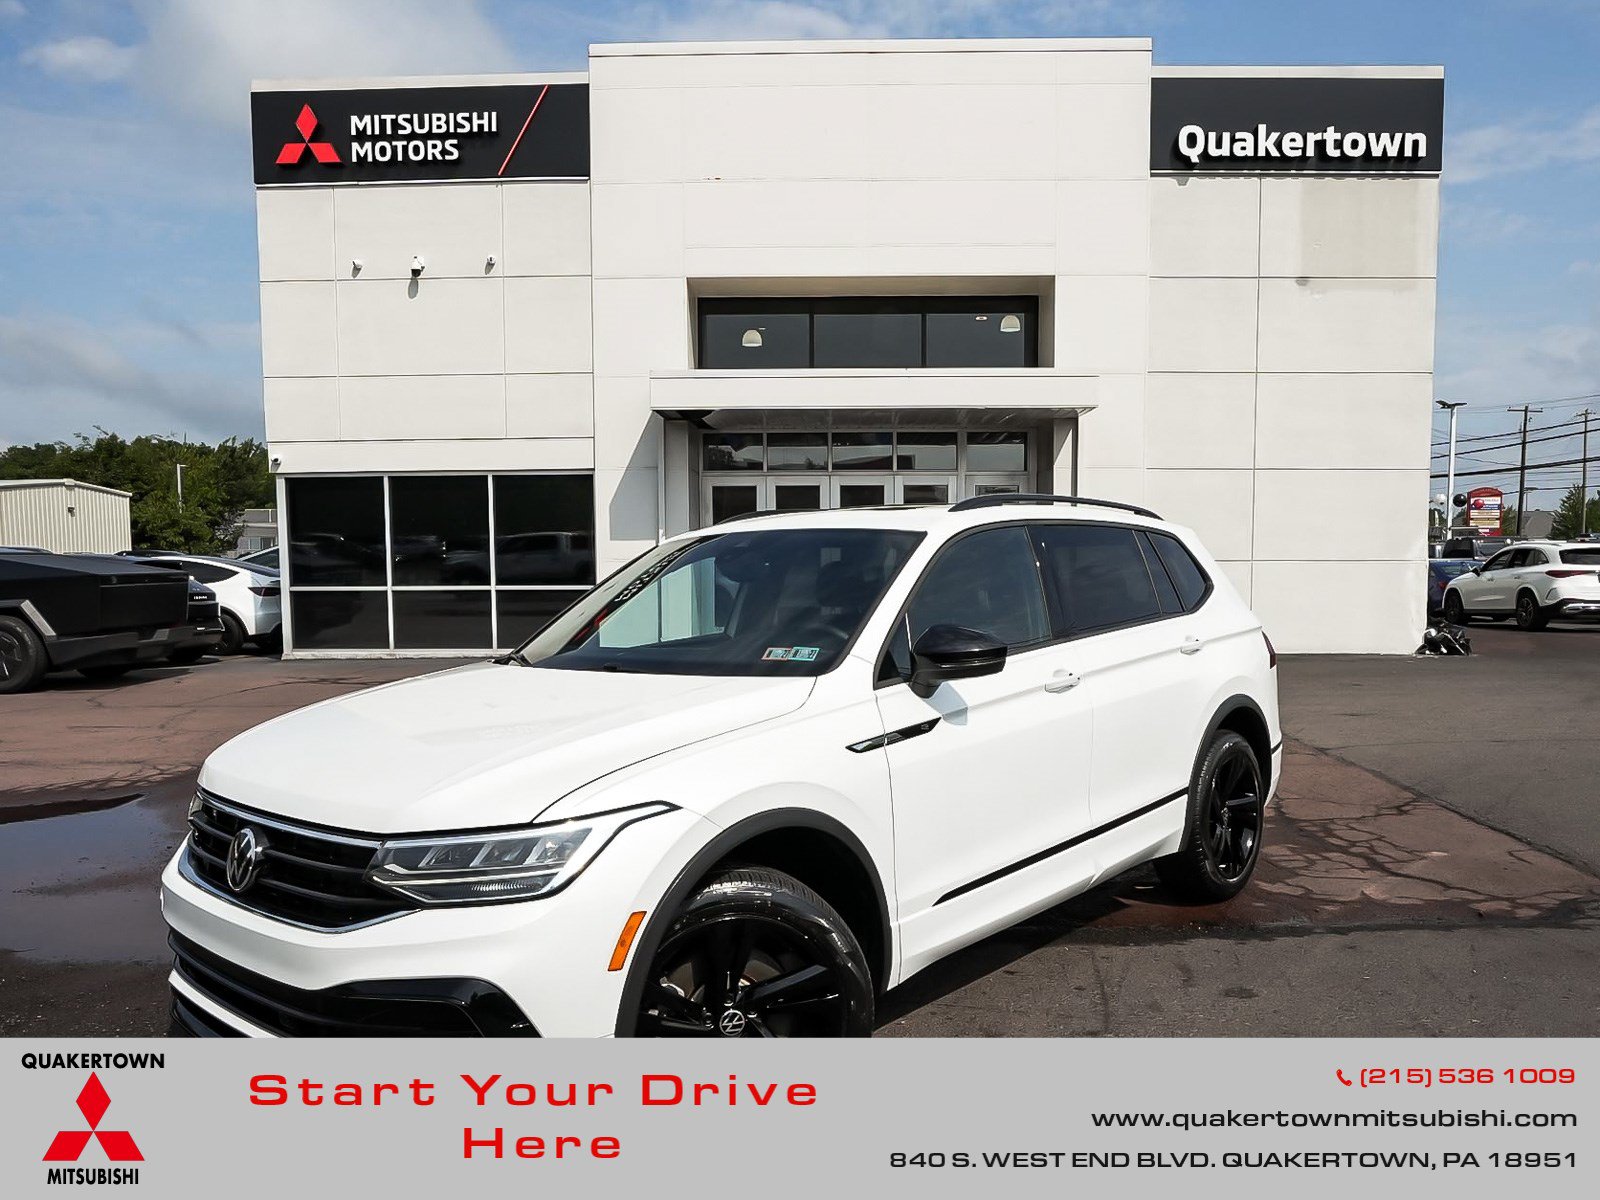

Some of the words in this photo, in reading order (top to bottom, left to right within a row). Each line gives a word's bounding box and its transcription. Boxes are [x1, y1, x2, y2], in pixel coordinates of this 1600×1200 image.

[350, 111, 497, 135] MITSUBISHI
[351, 139, 460, 163] MOTORS
[1178, 124, 1427, 163] Quakertown
